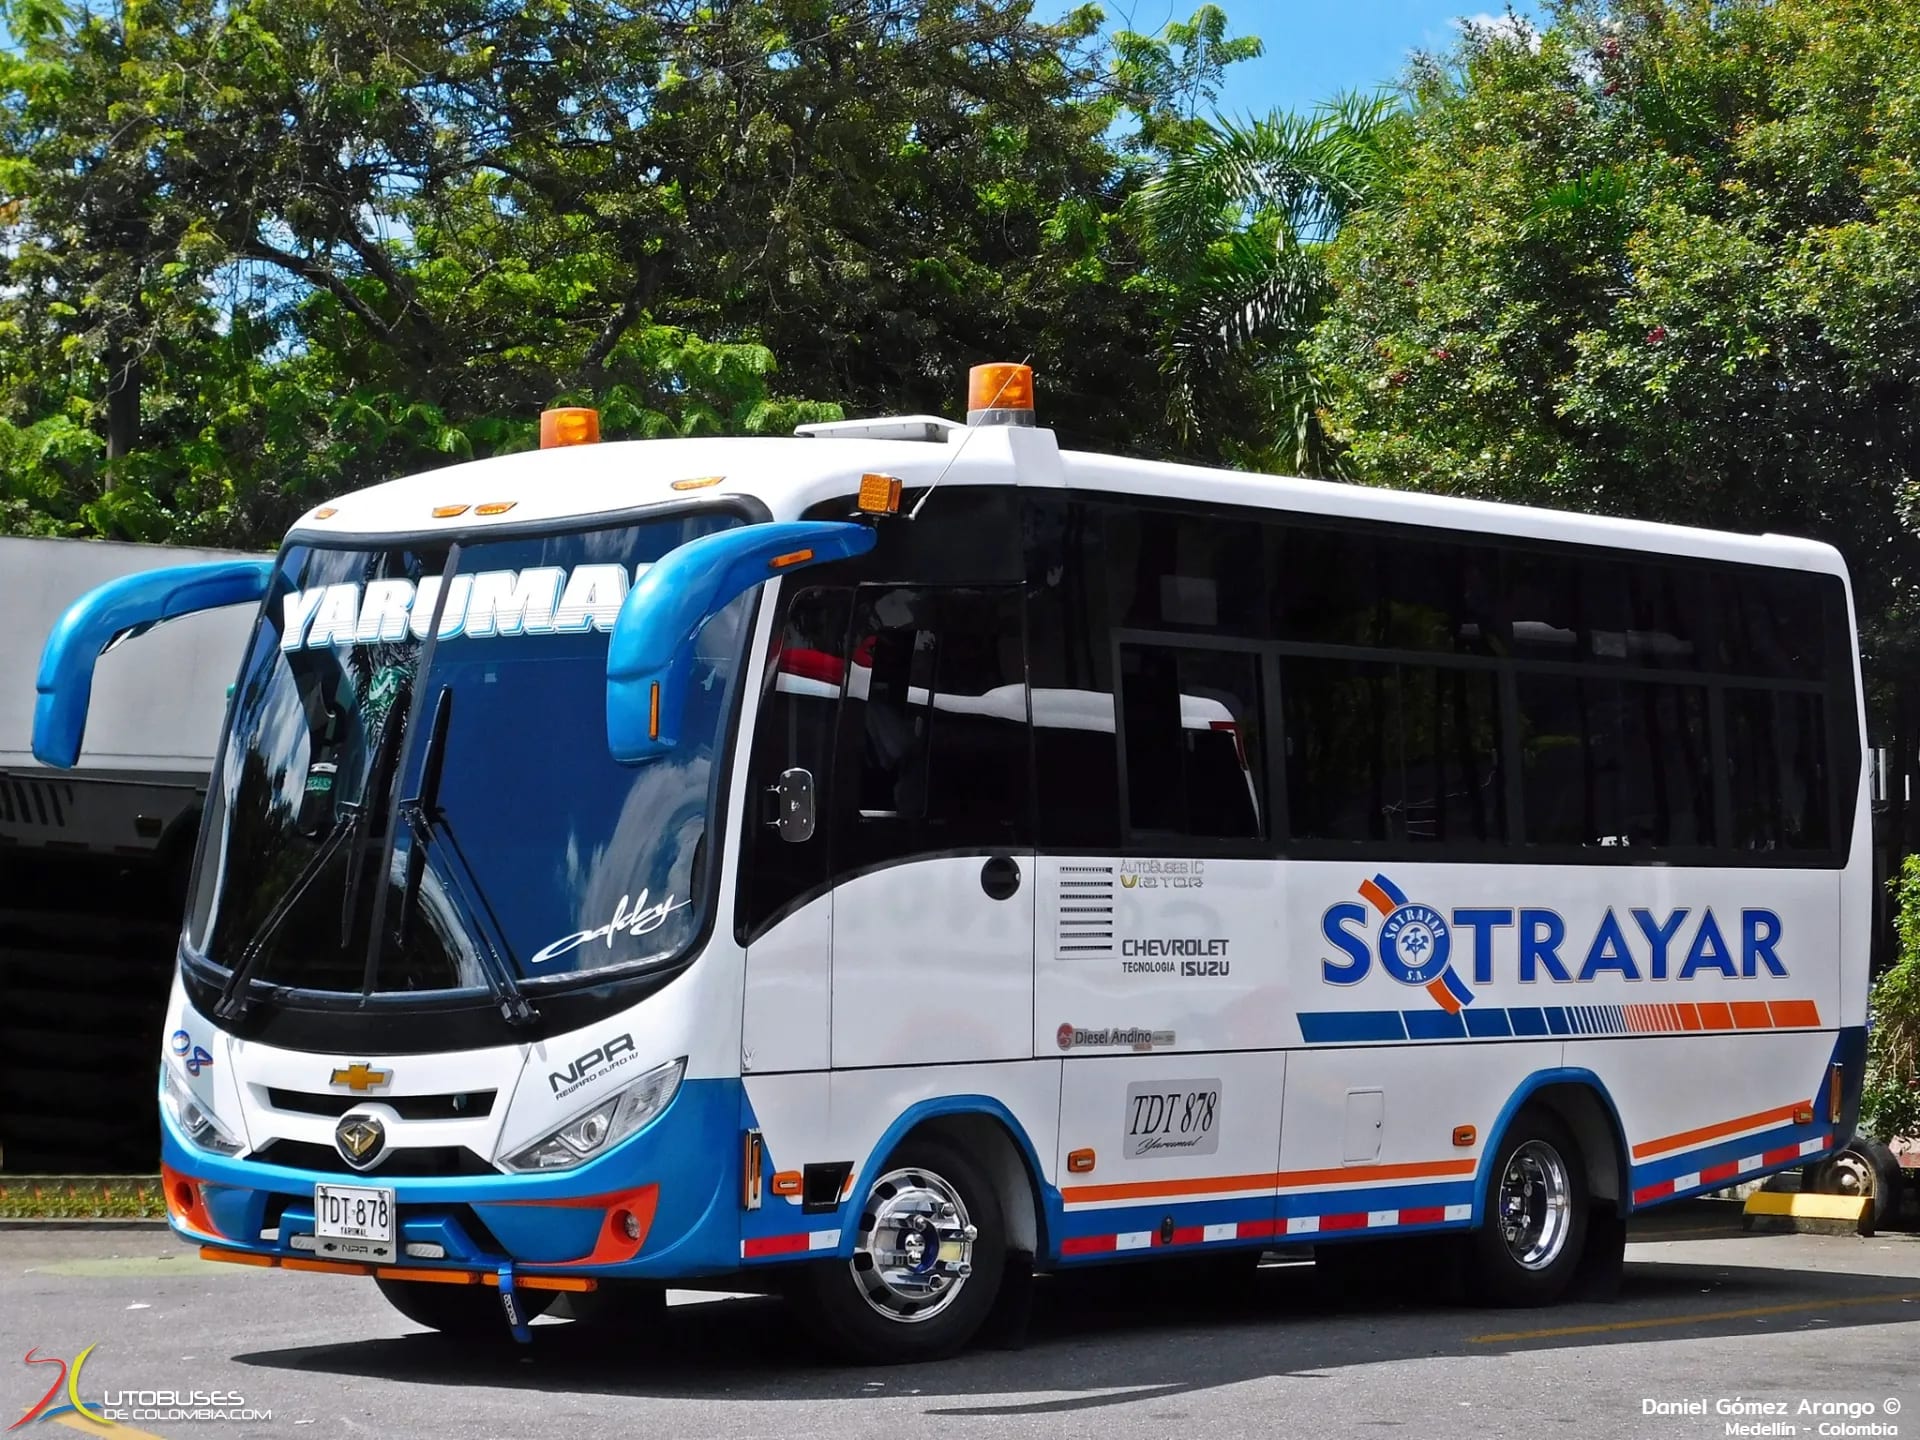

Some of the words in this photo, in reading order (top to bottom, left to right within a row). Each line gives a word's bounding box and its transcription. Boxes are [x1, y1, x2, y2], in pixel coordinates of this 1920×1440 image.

[280, 563, 655, 650] YARUMA
[1385, 909, 1445, 939] SOTRAYAR
[1122, 939, 1229, 956] CHEVROLET
[1321, 900, 1790, 987] SOTRAYAR
[1122, 961, 1176, 973] TECNOLOGIA
[1180, 961, 1229, 976] ISUZU
[1075, 1030, 1108, 1045] Diesel
[1111, 1030, 1152, 1044] Andino
[548, 1033, 636, 1093] NPR
[555, 1073, 597, 1101] REWARD
[598, 1058, 627, 1077] EURO
[1129, 1093, 1181, 1135] TDT
[1180, 1091, 1217, 1133] 878
[320, 1194, 351, 1226] TDT
[355, 1198, 389, 1228] 878
